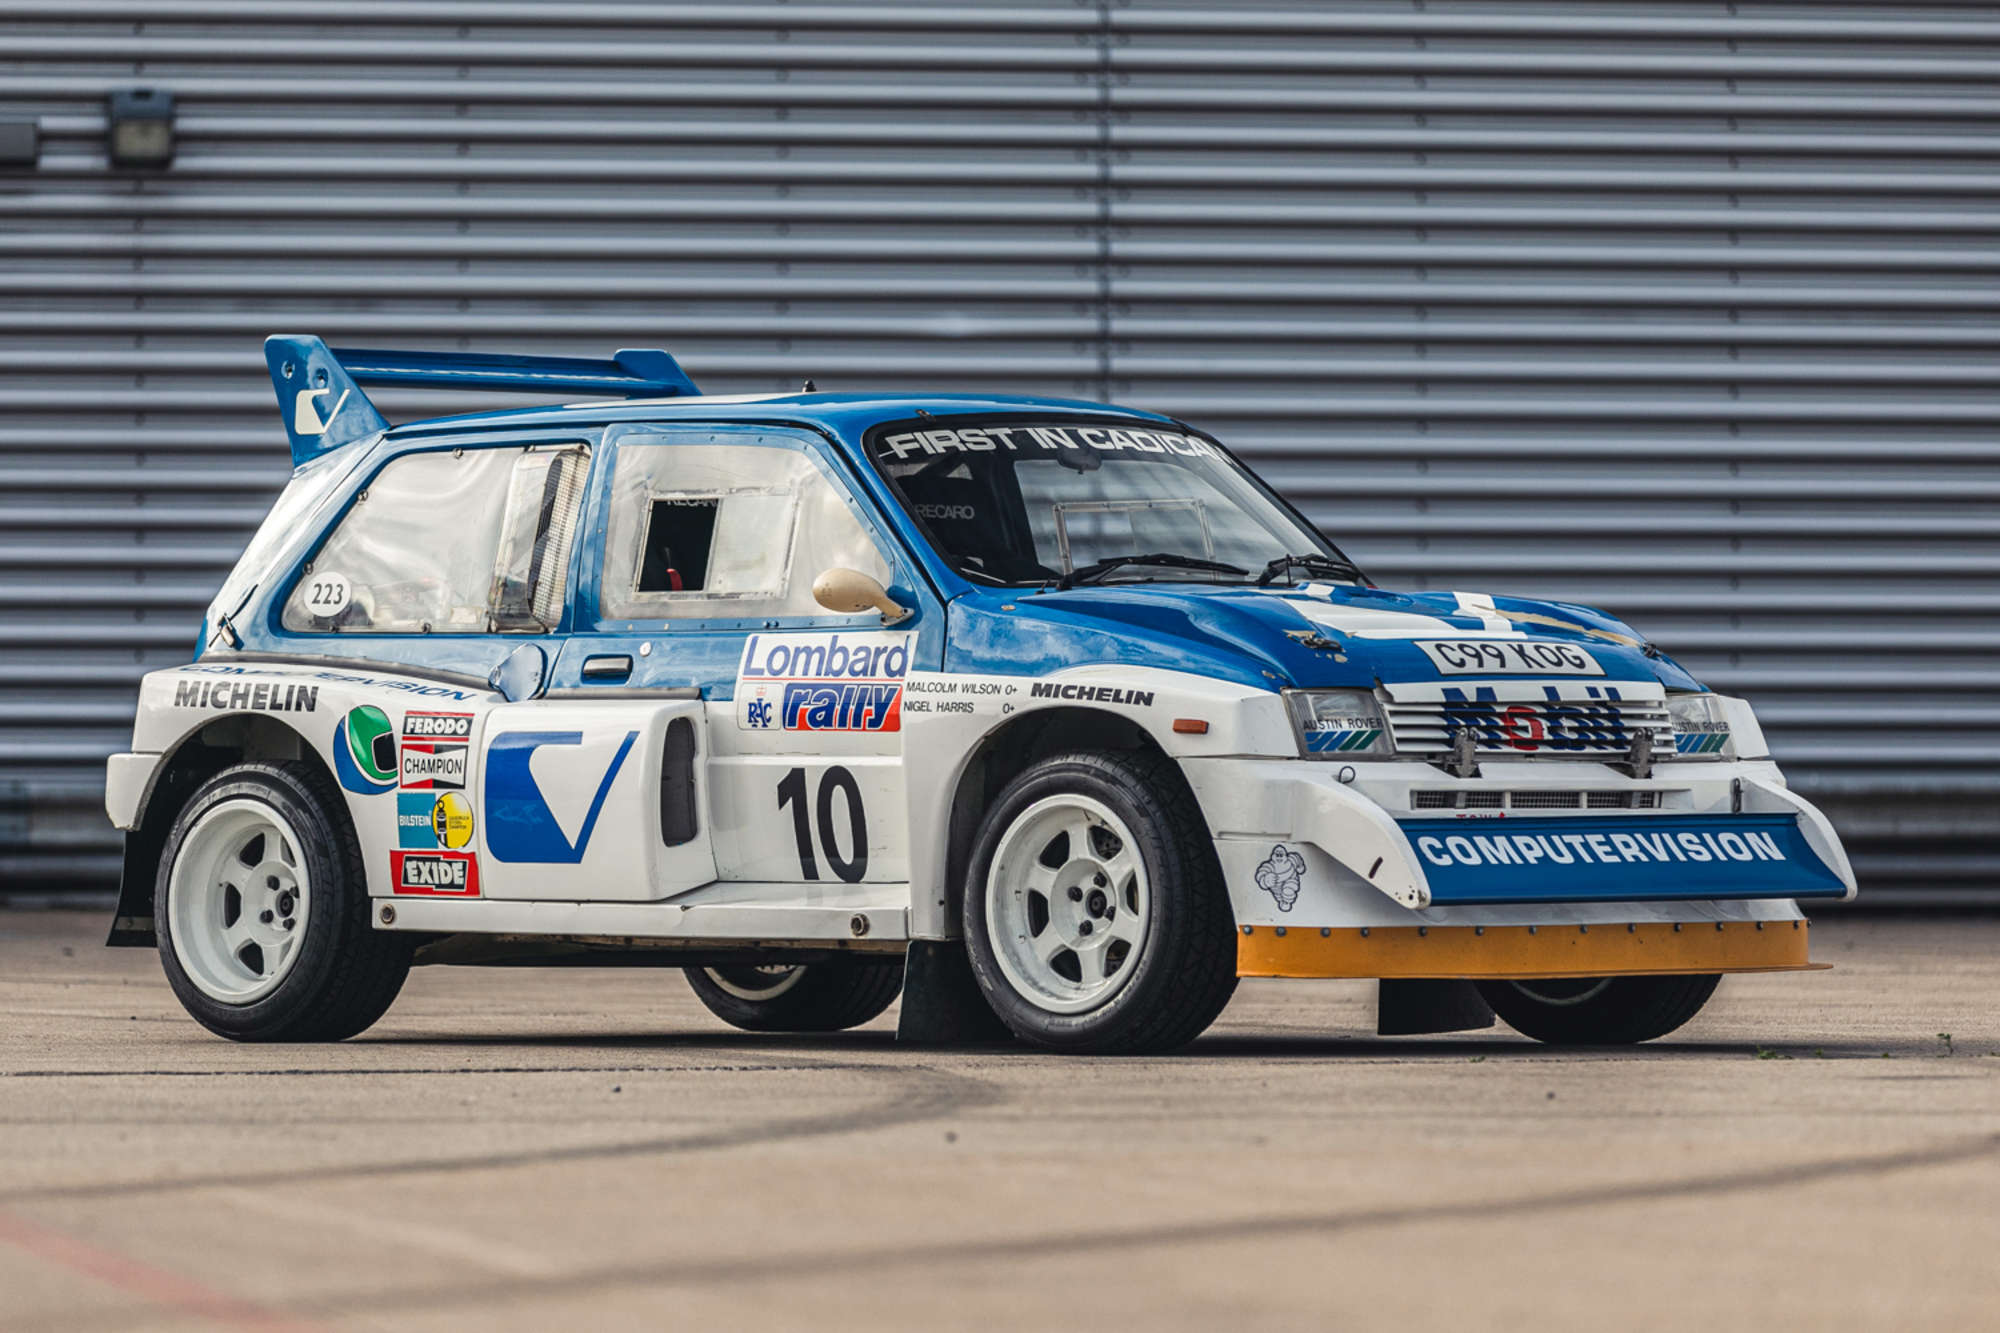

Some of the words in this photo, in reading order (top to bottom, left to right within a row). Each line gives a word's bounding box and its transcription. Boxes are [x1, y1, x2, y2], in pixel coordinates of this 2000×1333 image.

[884, 427, 1018, 460] FIRST
[1024, 427, 1080, 449] IN
[914, 503, 976, 520] RECARO
[311, 583, 344, 605] 223
[742, 634, 910, 678] Lombard
[1434, 642, 1507, 669] C99
[1507, 643, 1587, 670] KOG
[173, 679, 320, 713] MICHELIN
[906, 681, 958, 694] MALCOLM
[961, 683, 1002, 695] WILSON
[1030, 682, 1156, 707] MICHELIN
[784, 684, 903, 730] rally
[903, 700, 932, 713] NIGEL
[936, 701, 975, 714] HARRIS
[405, 717, 469, 735] FERODO
[1303, 718, 1343, 730] AUSTIN
[1347, 717, 1385, 729] ROVER
[404, 757, 463, 775] CHAMPION
[399, 814, 432, 827] BILSTEIN
[776, 765, 869, 884] 10
[1417, 831, 1786, 866] COMPUTERVISION
[405, 860, 466, 885] EXIDE
